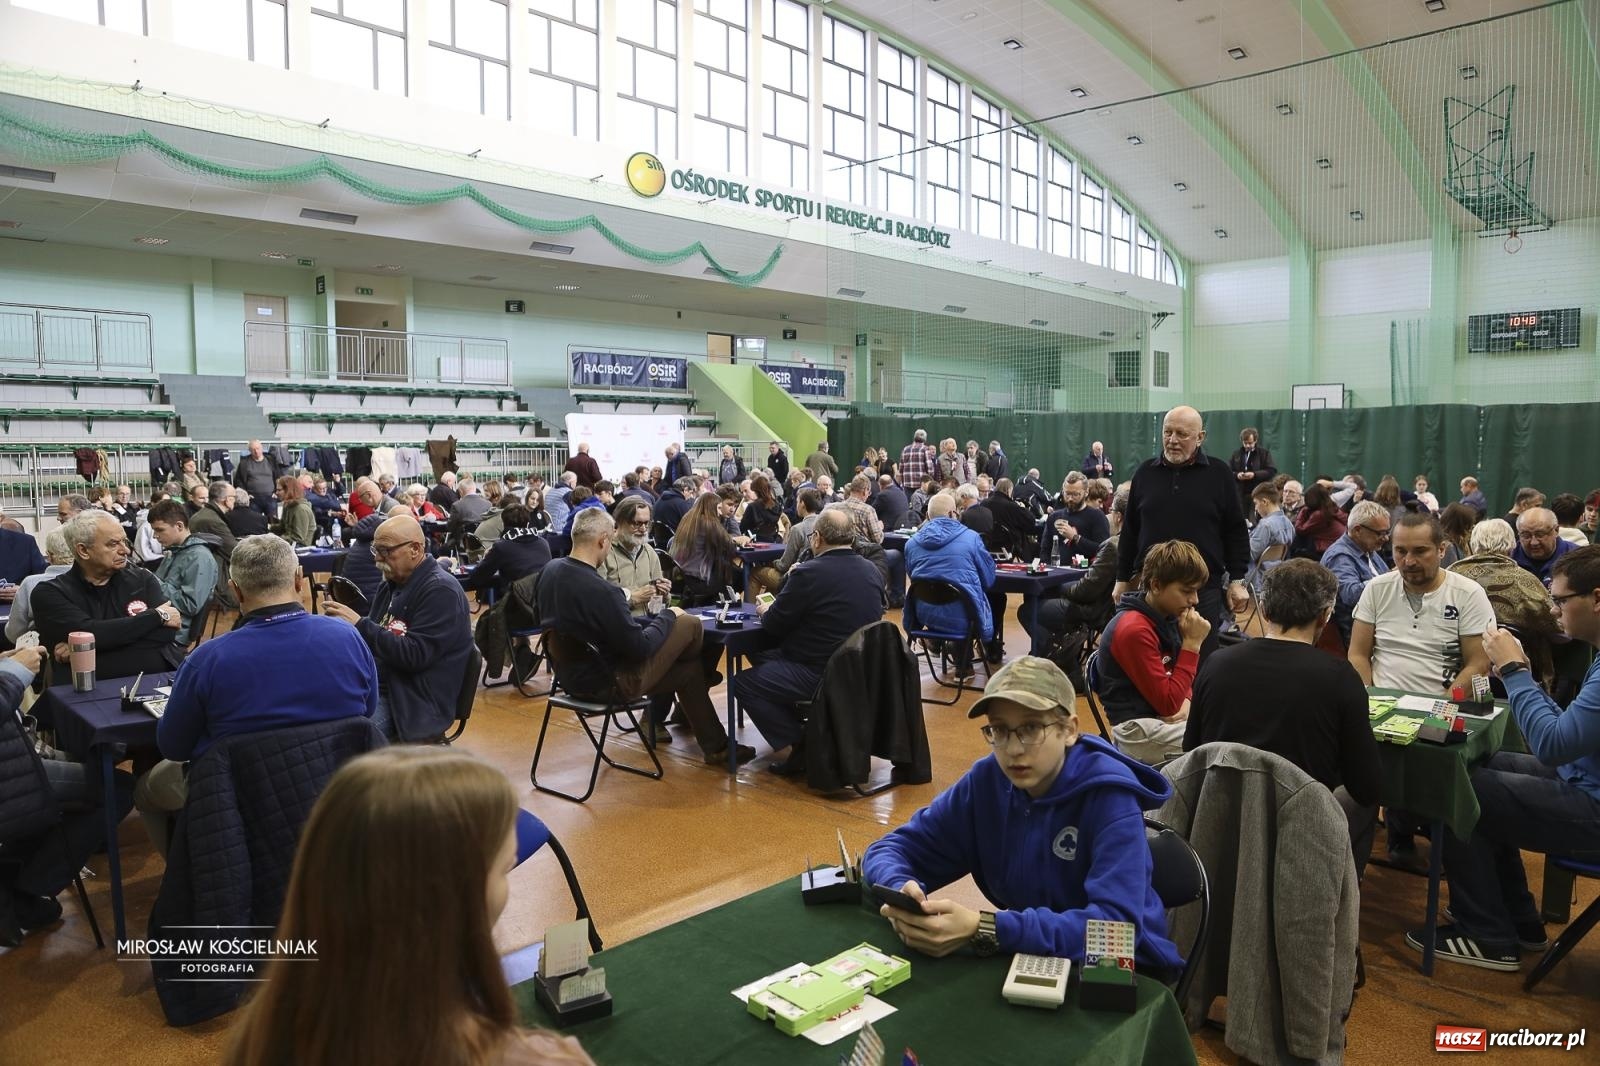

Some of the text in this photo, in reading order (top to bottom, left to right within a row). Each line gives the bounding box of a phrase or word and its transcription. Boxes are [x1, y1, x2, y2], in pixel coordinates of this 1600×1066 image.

[671, 168, 951, 249] OŚRODEK SPORTU I REKREACJI RACIBÓRZ
[583, 362, 634, 376] RACIBÓRZ
[802, 376, 838, 387] RACIBÓRZ
[679, 418, 686, 431] N
